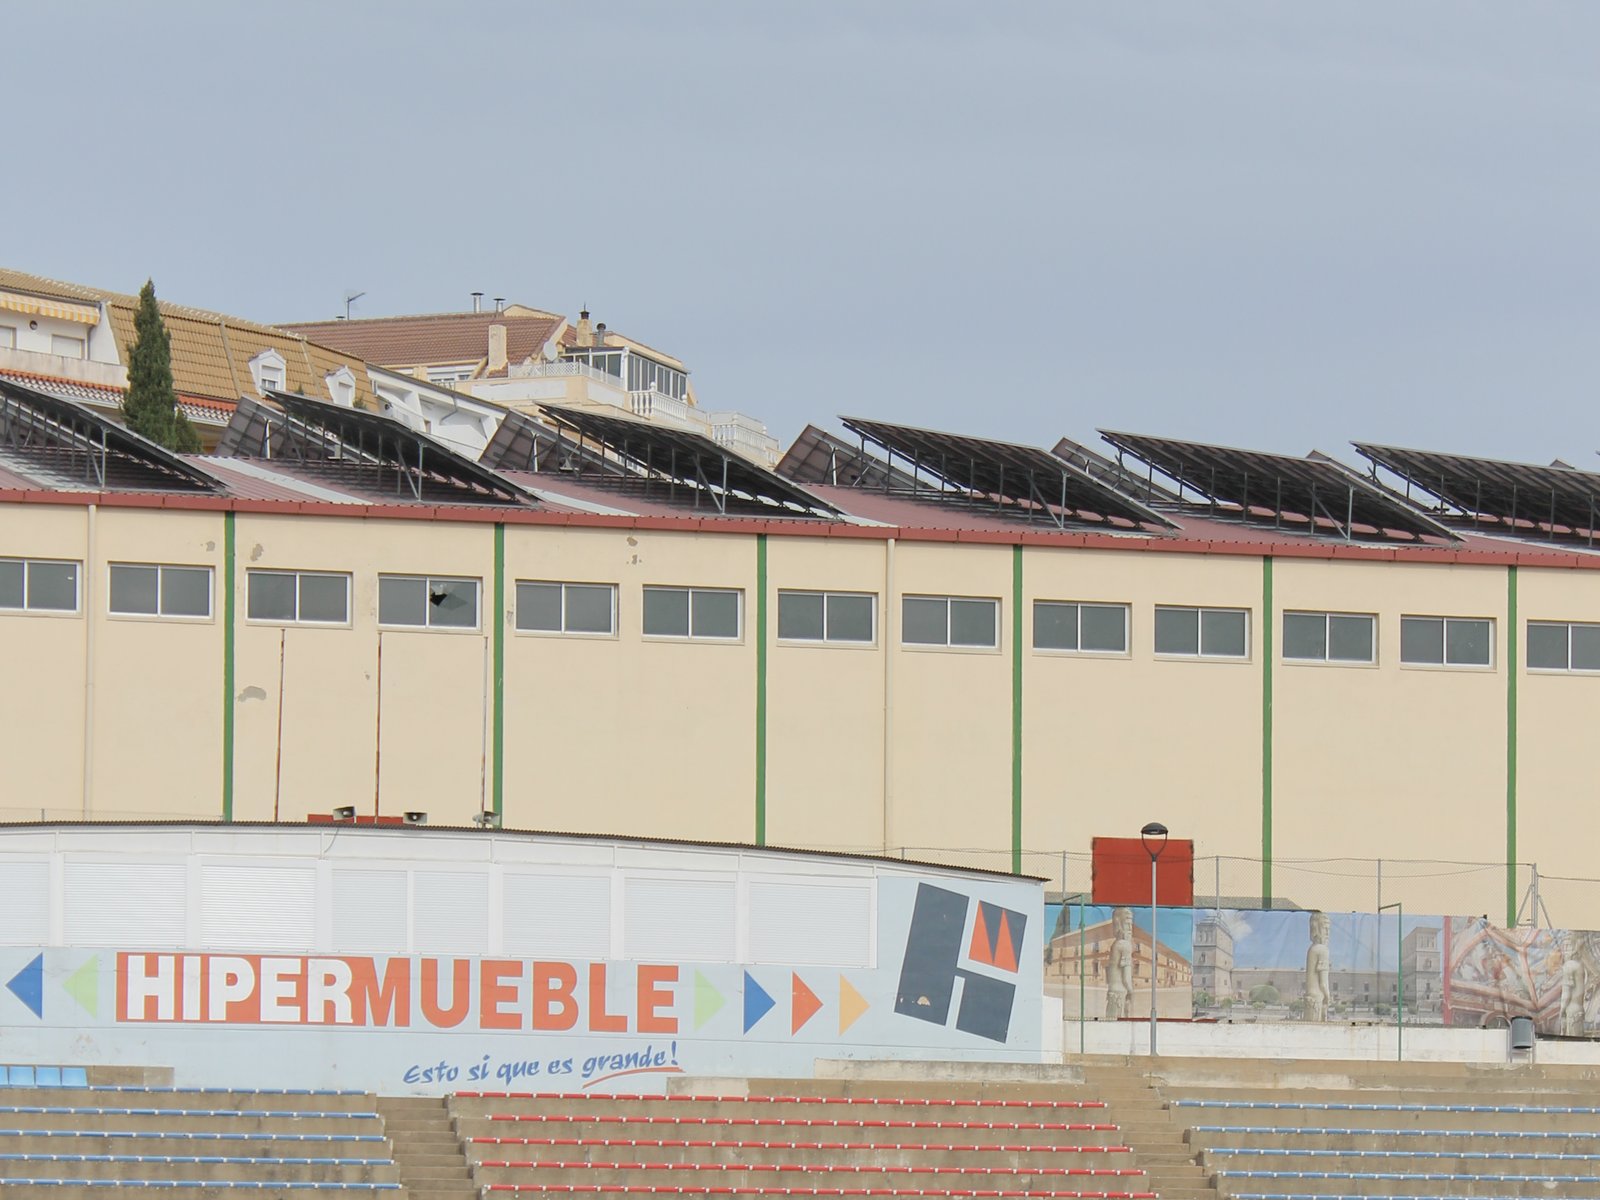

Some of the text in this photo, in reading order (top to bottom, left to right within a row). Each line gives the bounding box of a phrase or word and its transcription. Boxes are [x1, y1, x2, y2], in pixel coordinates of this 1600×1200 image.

[126, 954, 679, 1034] HIPERMUEBLE
[403, 1061, 458, 1084] Esto
[497, 1058, 540, 1086] que
[547, 1056, 573, 1075] es
